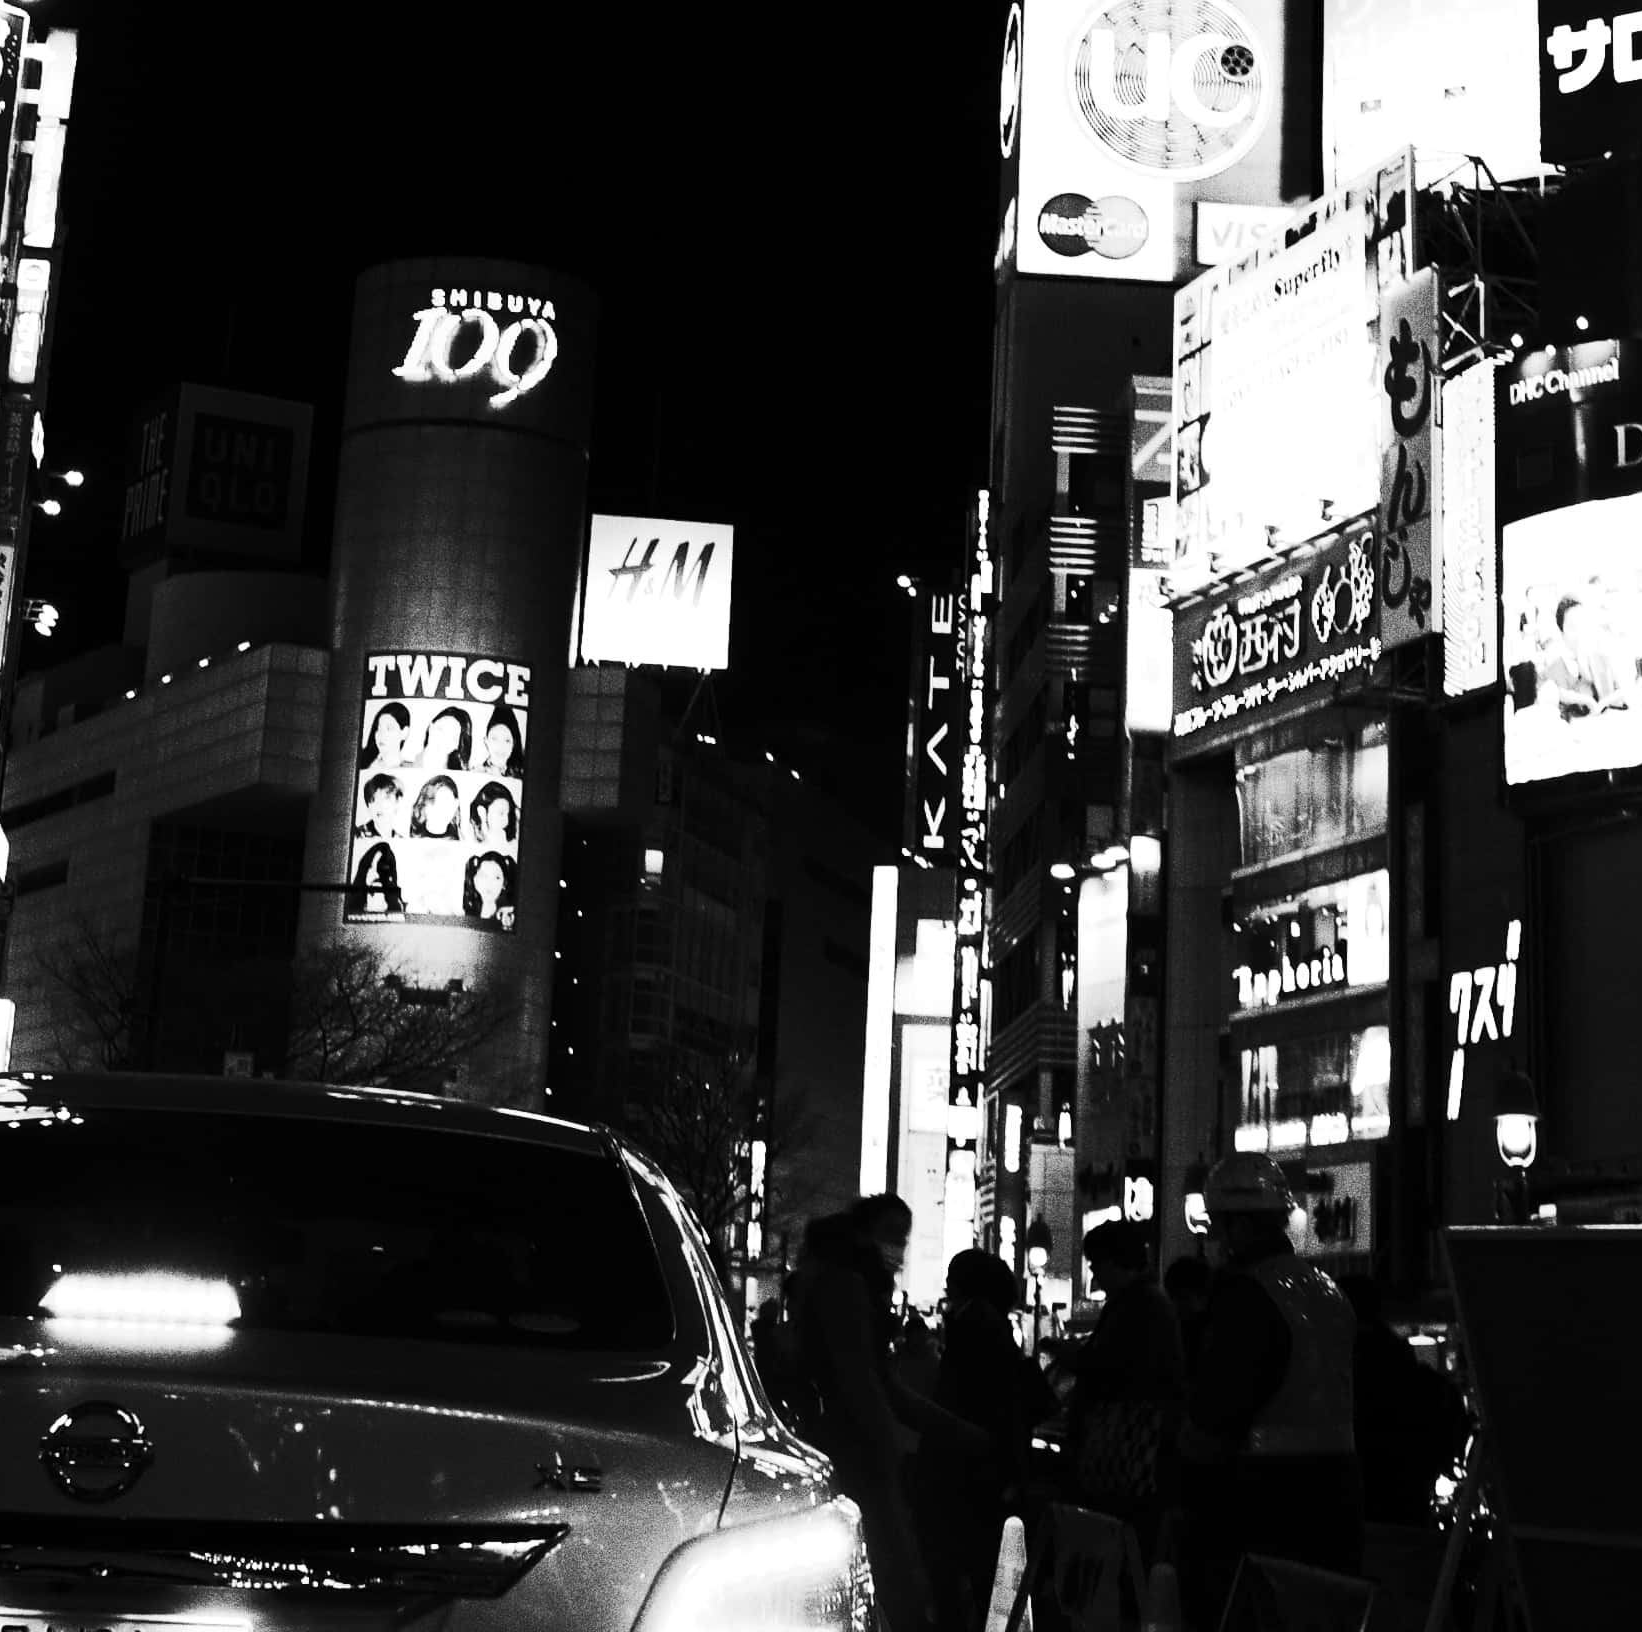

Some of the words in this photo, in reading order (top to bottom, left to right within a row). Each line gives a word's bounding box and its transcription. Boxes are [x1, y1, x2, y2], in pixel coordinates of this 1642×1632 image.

[1211, 220, 1269, 249] VIS
[431, 288, 557, 321] SHIBUYA
[391, 306, 558, 409] 109
[1510, 373, 1544, 406] DHC
[1545, 357, 1620, 396] Channel
[608, 536, 717, 608] H&M
[367, 654, 531, 707] TWICE
